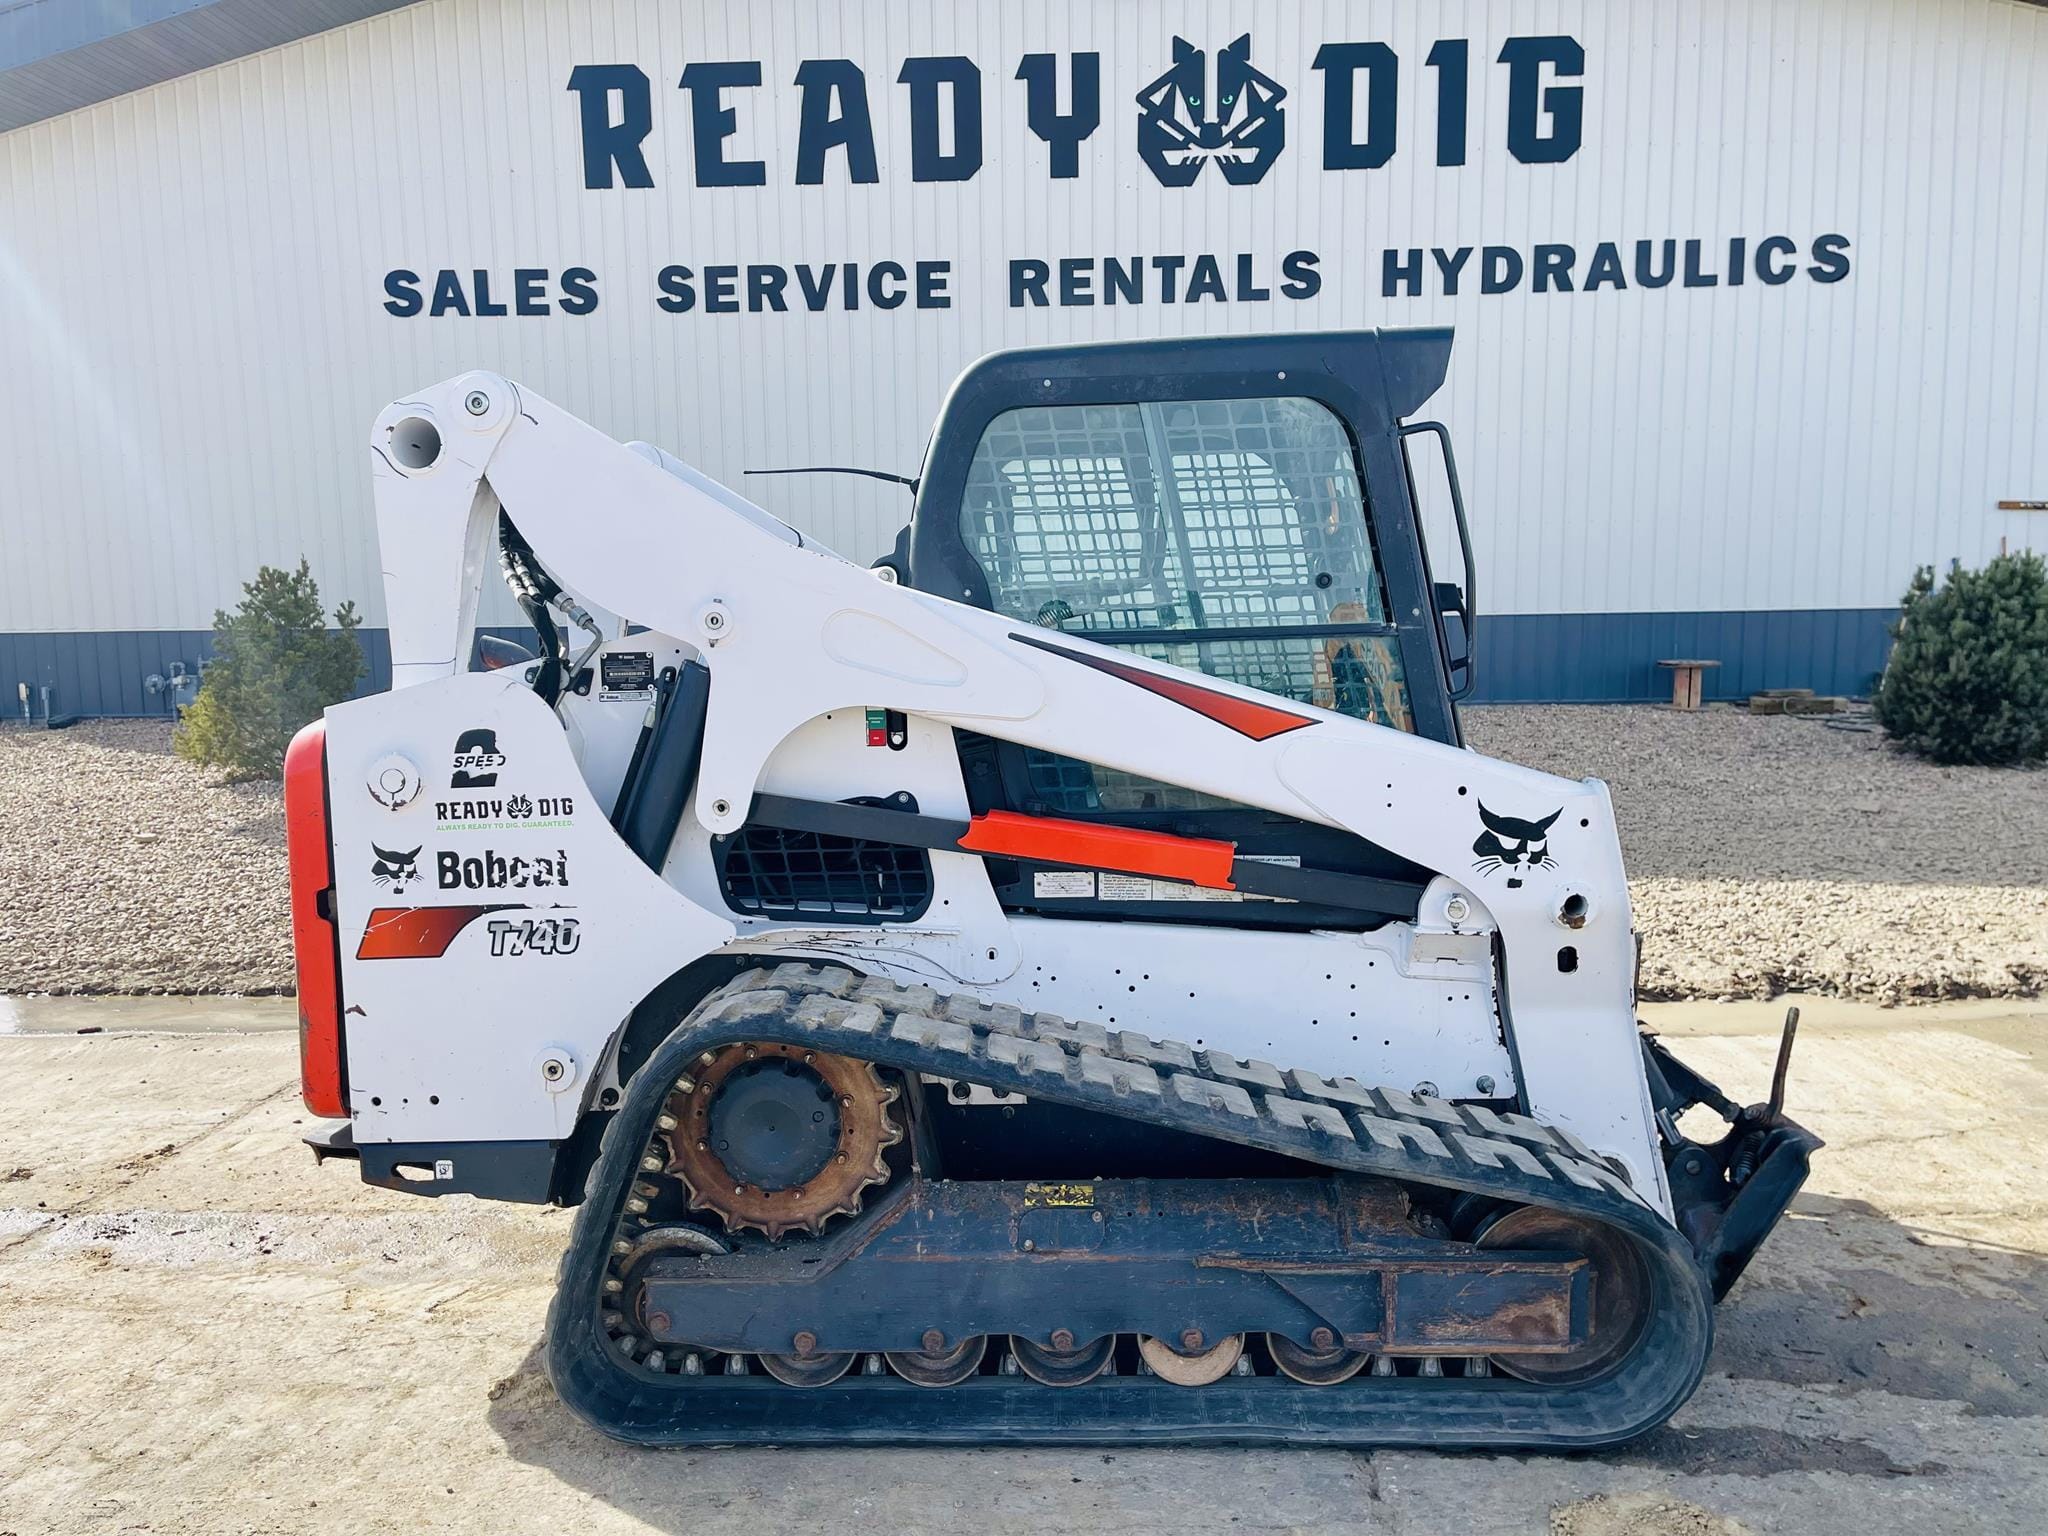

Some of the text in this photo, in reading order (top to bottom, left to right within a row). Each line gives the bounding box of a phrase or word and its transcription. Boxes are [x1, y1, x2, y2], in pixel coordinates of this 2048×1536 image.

[566, 35, 1585, 190] READY DIG
[383, 233, 1851, 318] SALES SERVICE RENTALS HYDRAULICS
[434, 797, 574, 821] READY DIG
[436, 823, 466, 832] ALWAYS
[467, 823, 492, 831] READY
[494, 822, 504, 830] TO
[522, 820, 575, 829] GUARANTEED.
[487, 918, 581, 957] T740
